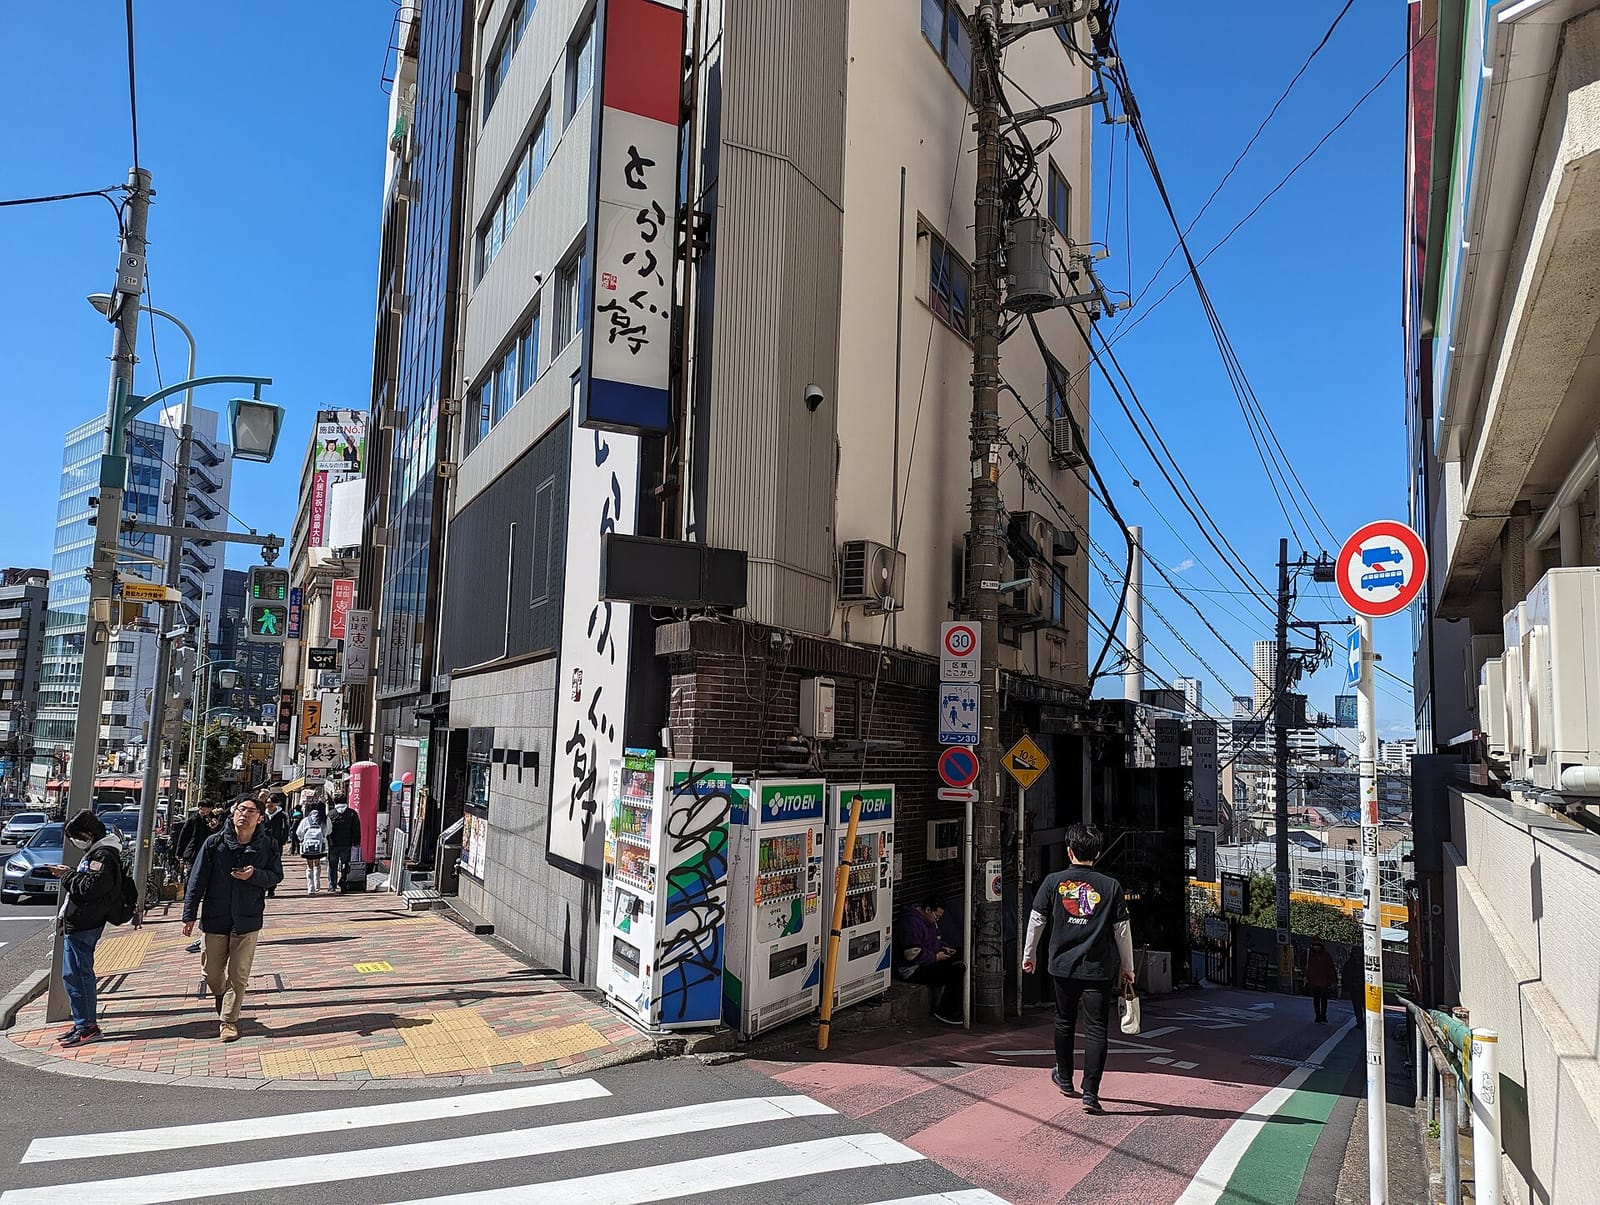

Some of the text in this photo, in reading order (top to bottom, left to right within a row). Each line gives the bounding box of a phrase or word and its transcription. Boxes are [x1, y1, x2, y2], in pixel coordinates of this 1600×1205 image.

[597, 144, 670, 355] とらふぐ亭
[952, 634, 969, 648] 30
[941, 735, 976, 743] ゾーン30
[1019, 750, 1037, 766] 10%
[695, 779, 726, 789] 伊藤園
[783, 794, 816, 811] ITO EN
[874, 798, 886, 811] EN
